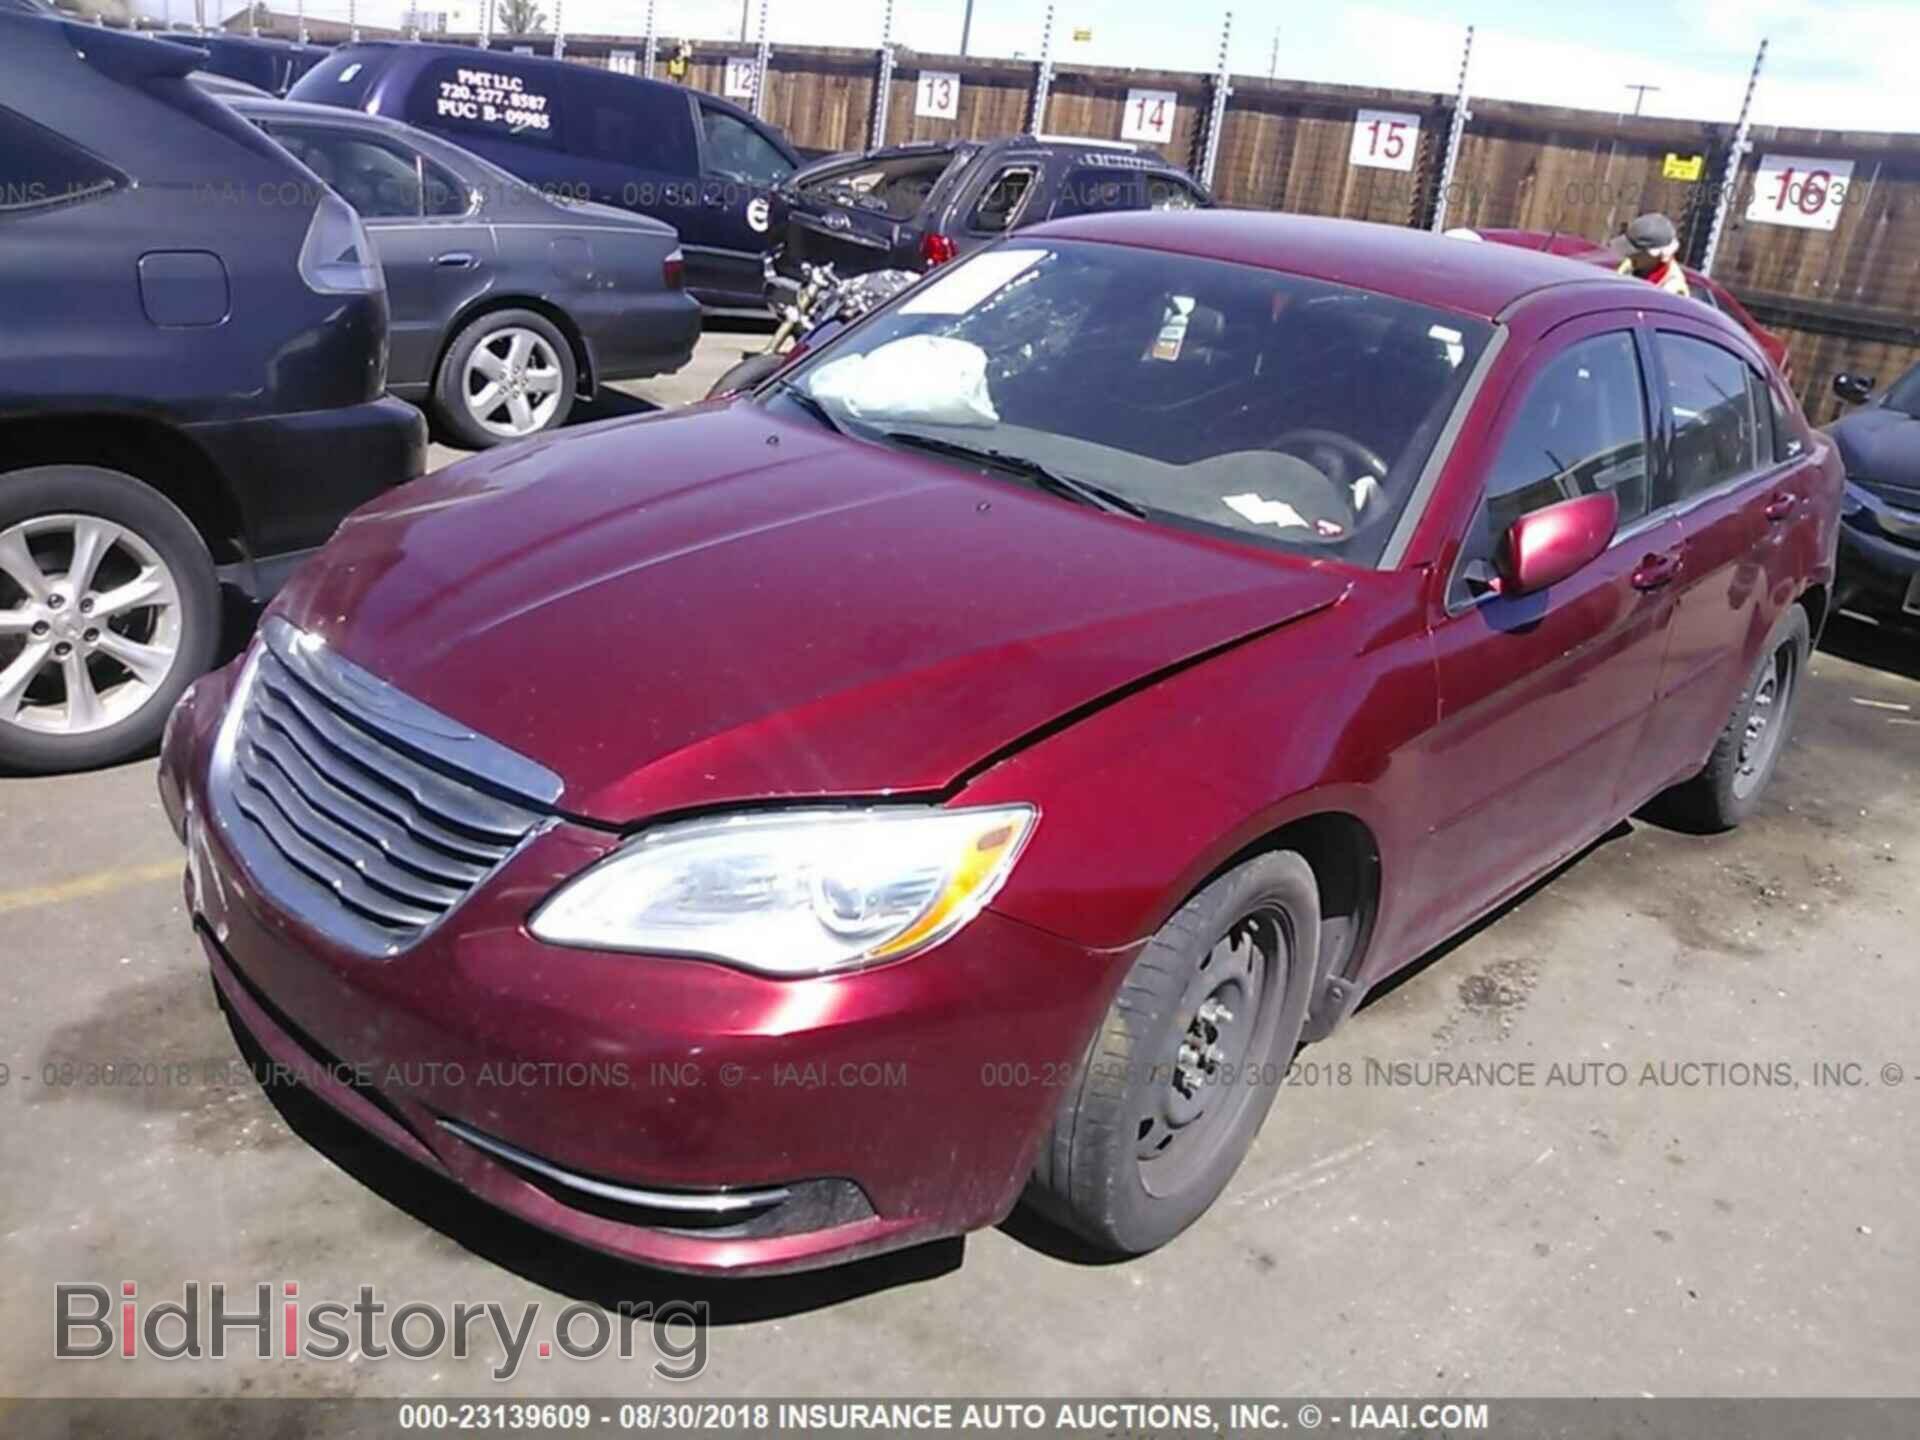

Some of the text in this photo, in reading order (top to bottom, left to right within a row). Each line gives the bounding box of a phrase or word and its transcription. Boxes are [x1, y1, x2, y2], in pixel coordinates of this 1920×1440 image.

[493, 74, 522, 92] LLC
[732, 64, 752, 89] 12
[438, 98, 478, 118] PUC
[926, 77, 951, 109] 13
[1136, 97, 1165, 132] 14
[1368, 120, 1408, 158] 15
[1775, 167, 1831, 215] 16
